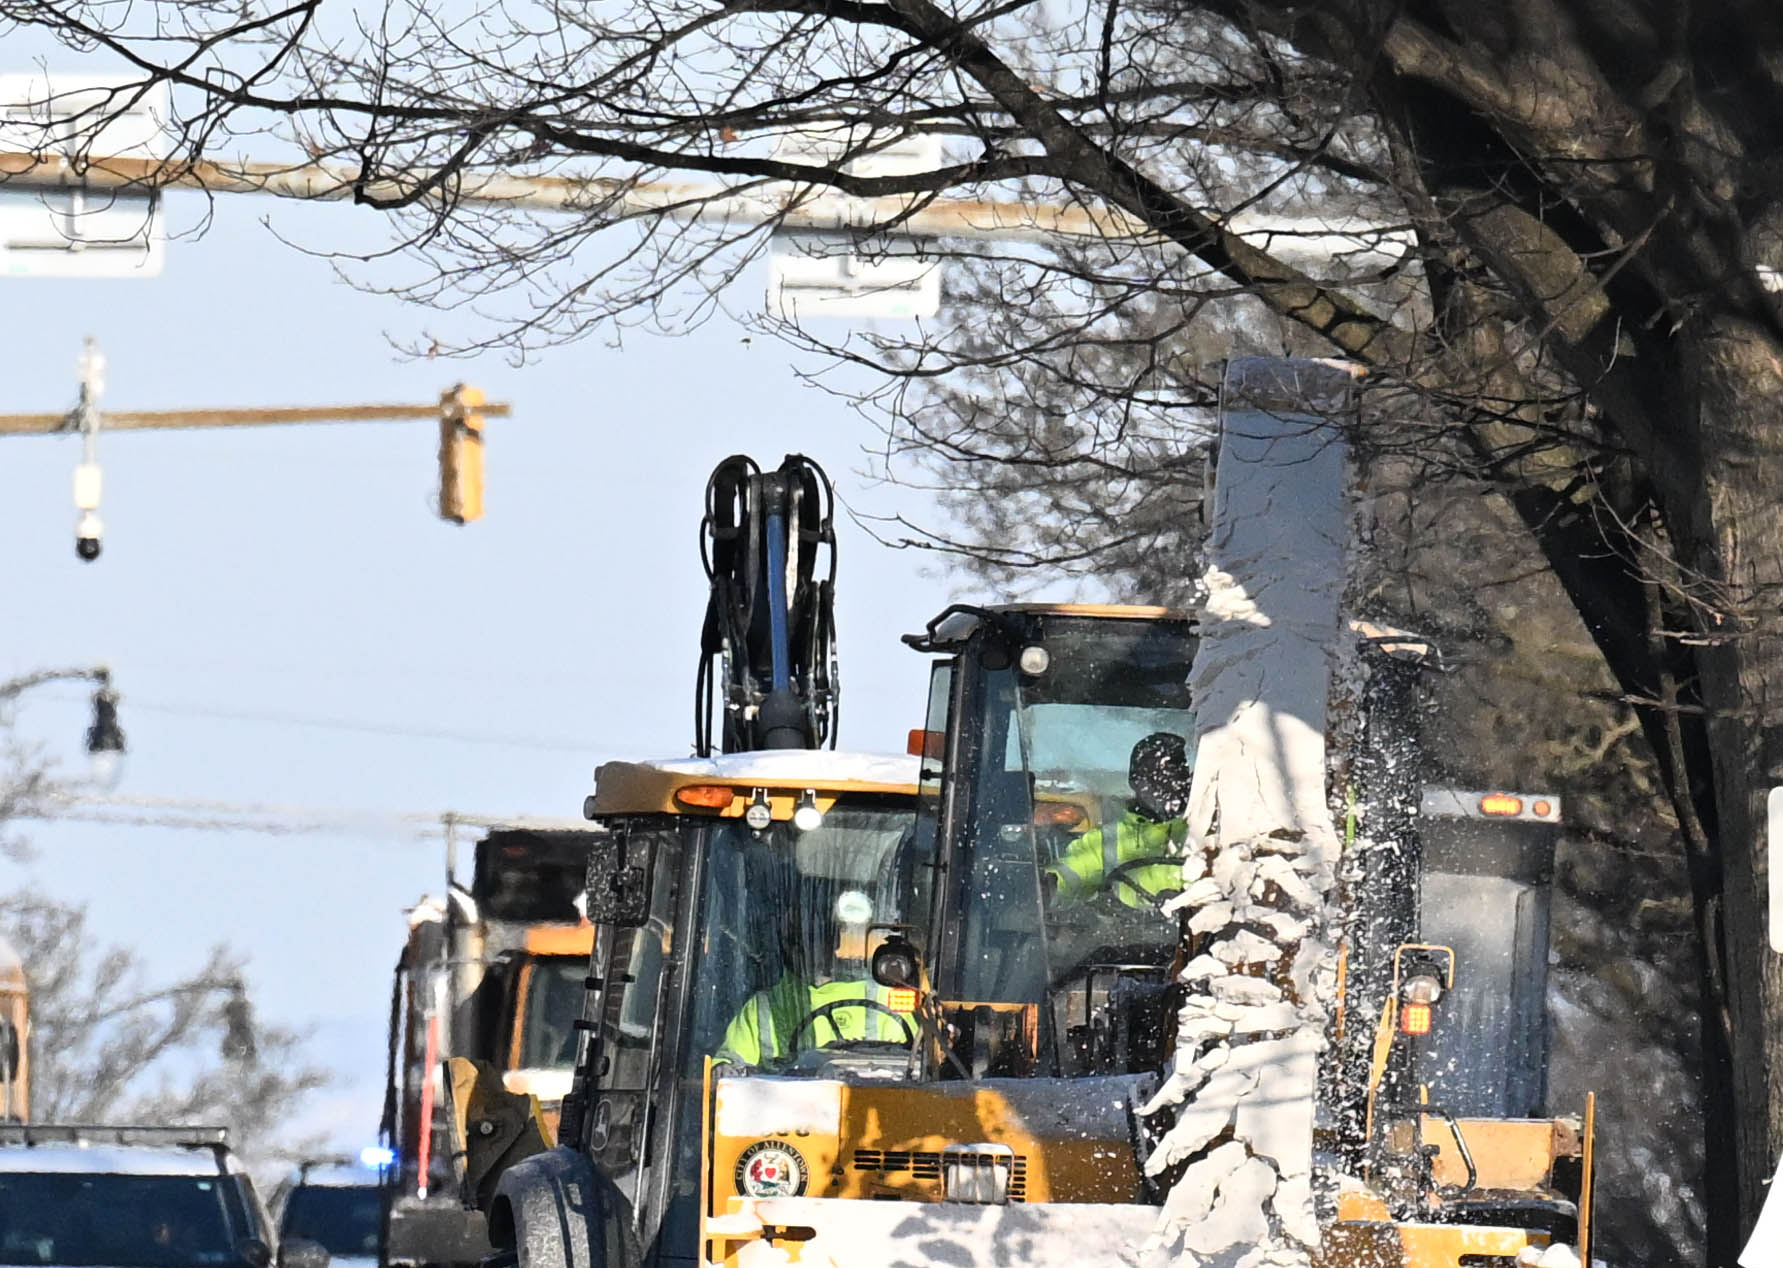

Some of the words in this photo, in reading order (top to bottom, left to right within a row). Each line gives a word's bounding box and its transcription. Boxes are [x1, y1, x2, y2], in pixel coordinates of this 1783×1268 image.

[735, 1157, 746, 1181] CITY
[746, 1144, 760, 1156] OF
[763, 1140, 808, 1182] ALLENTOWN
